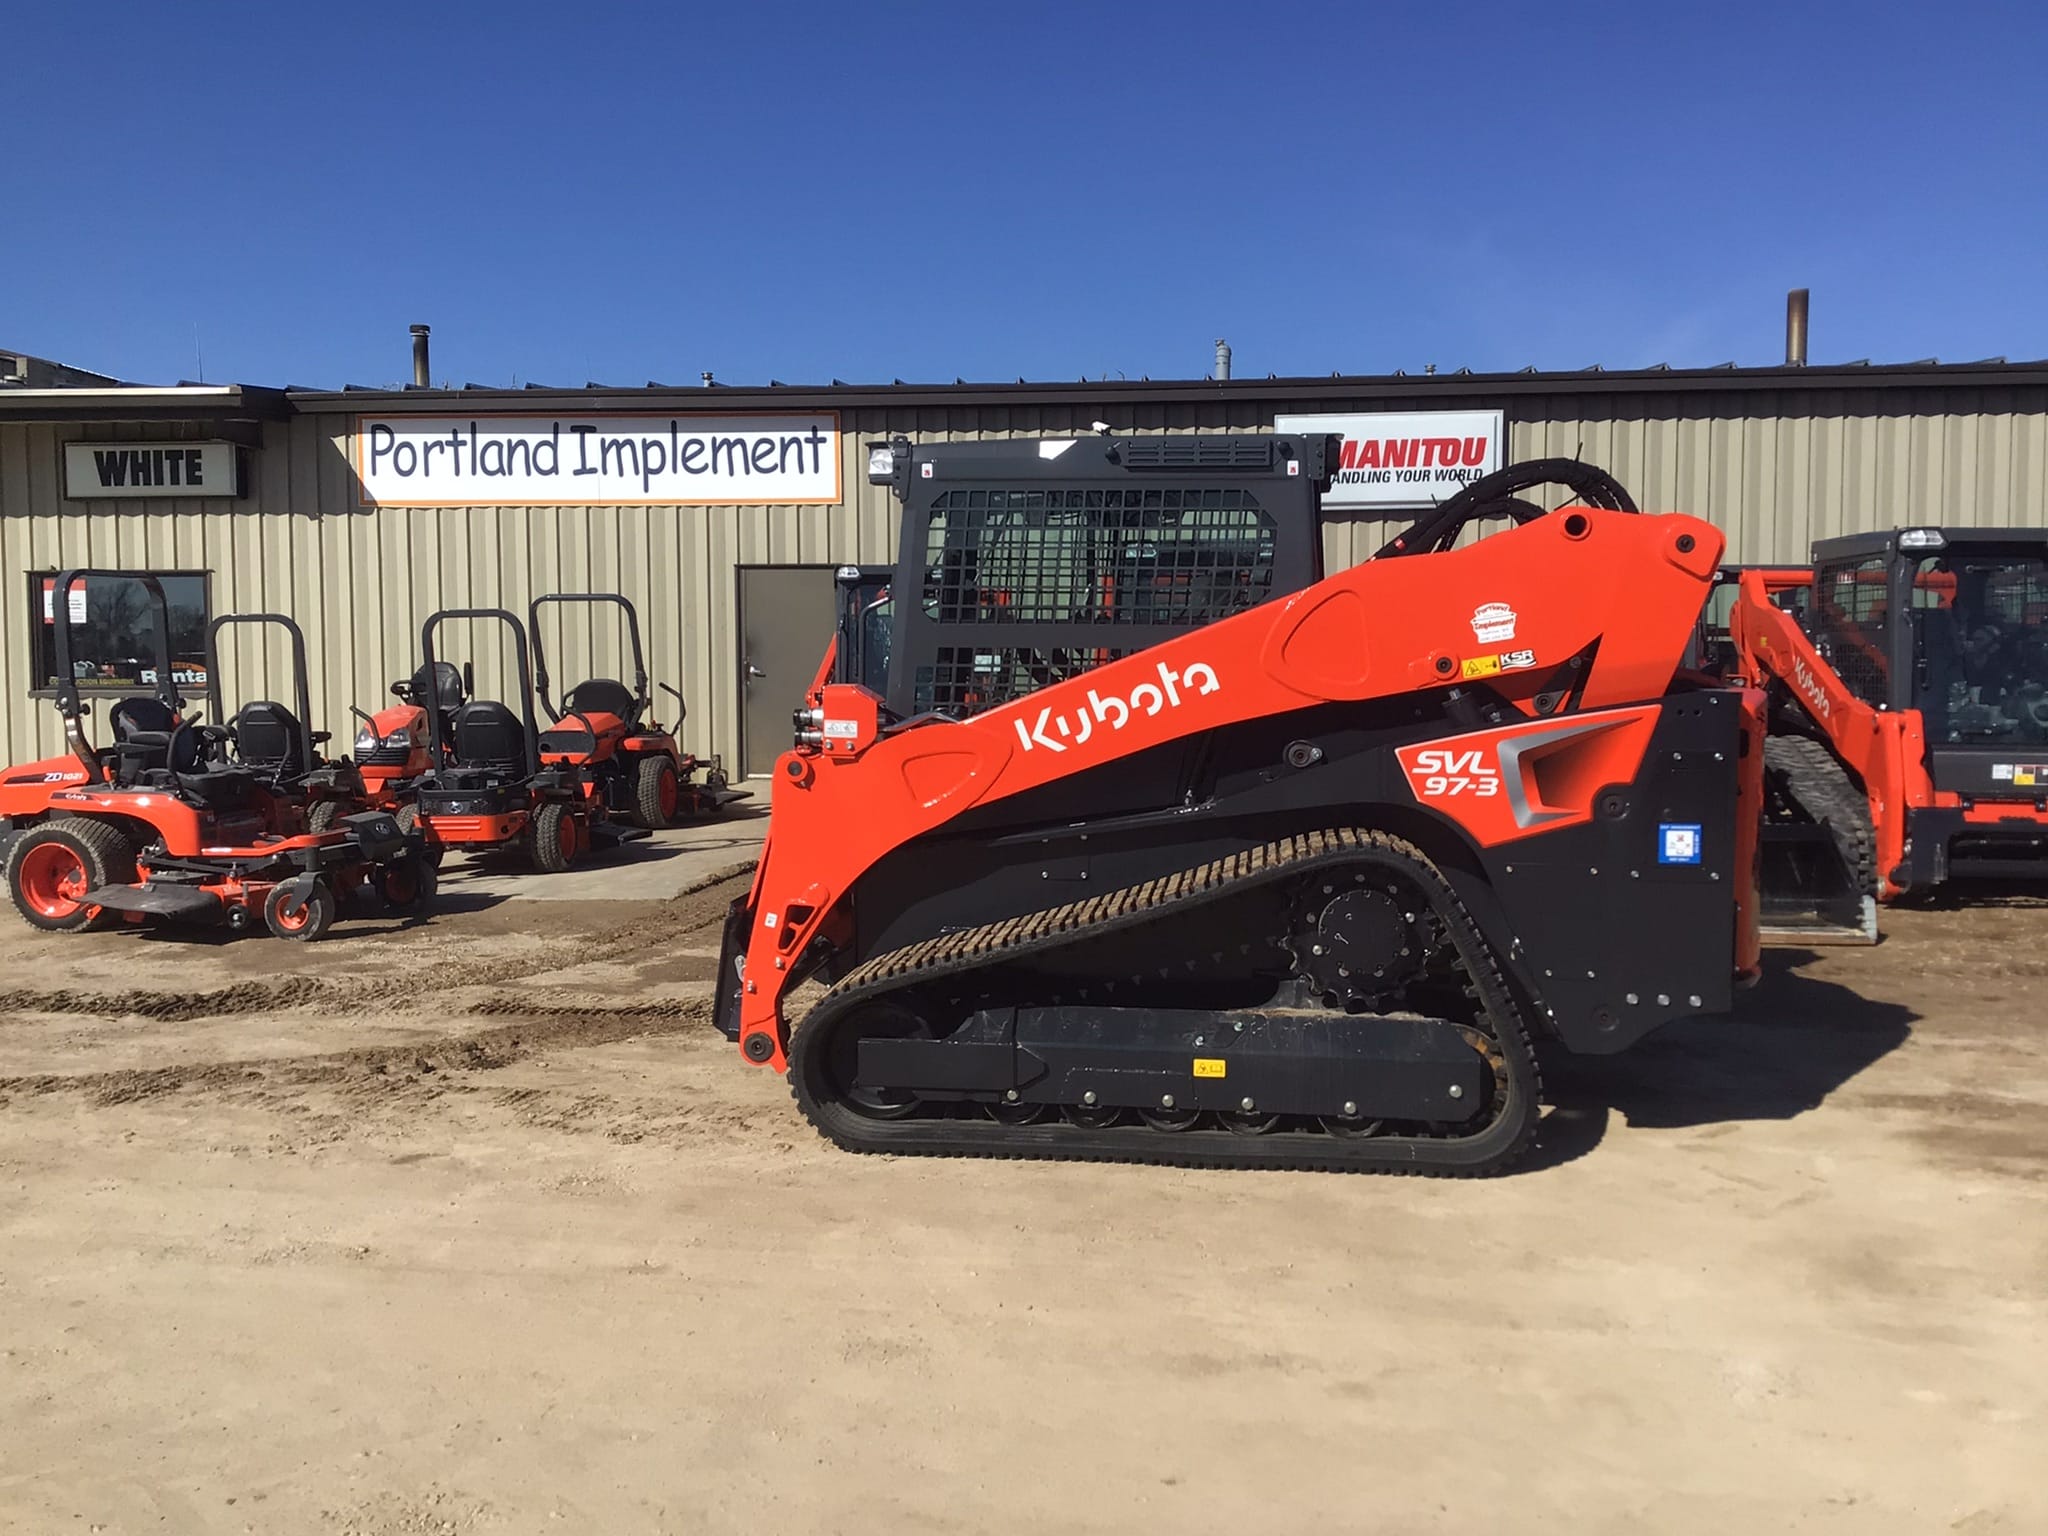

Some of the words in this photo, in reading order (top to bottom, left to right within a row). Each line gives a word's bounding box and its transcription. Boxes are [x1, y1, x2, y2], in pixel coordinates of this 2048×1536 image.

[93, 449, 203, 487] WHITE
[371, 421, 560, 477] Portland
[569, 420, 828, 494] Implement
[1340, 437, 1488, 469] MANITOU
[1331, 470, 1392, 485] ANDLING
[1396, 470, 1431, 482] YOUR
[1434, 468, 1483, 482] WORLD
[1501, 650, 1535, 665] KSR
[1794, 656, 1830, 718] Kubota
[1013, 661, 1221, 753] Kubota
[1411, 750, 1497, 775] SVL
[1423, 776, 1500, 797] 97-3
